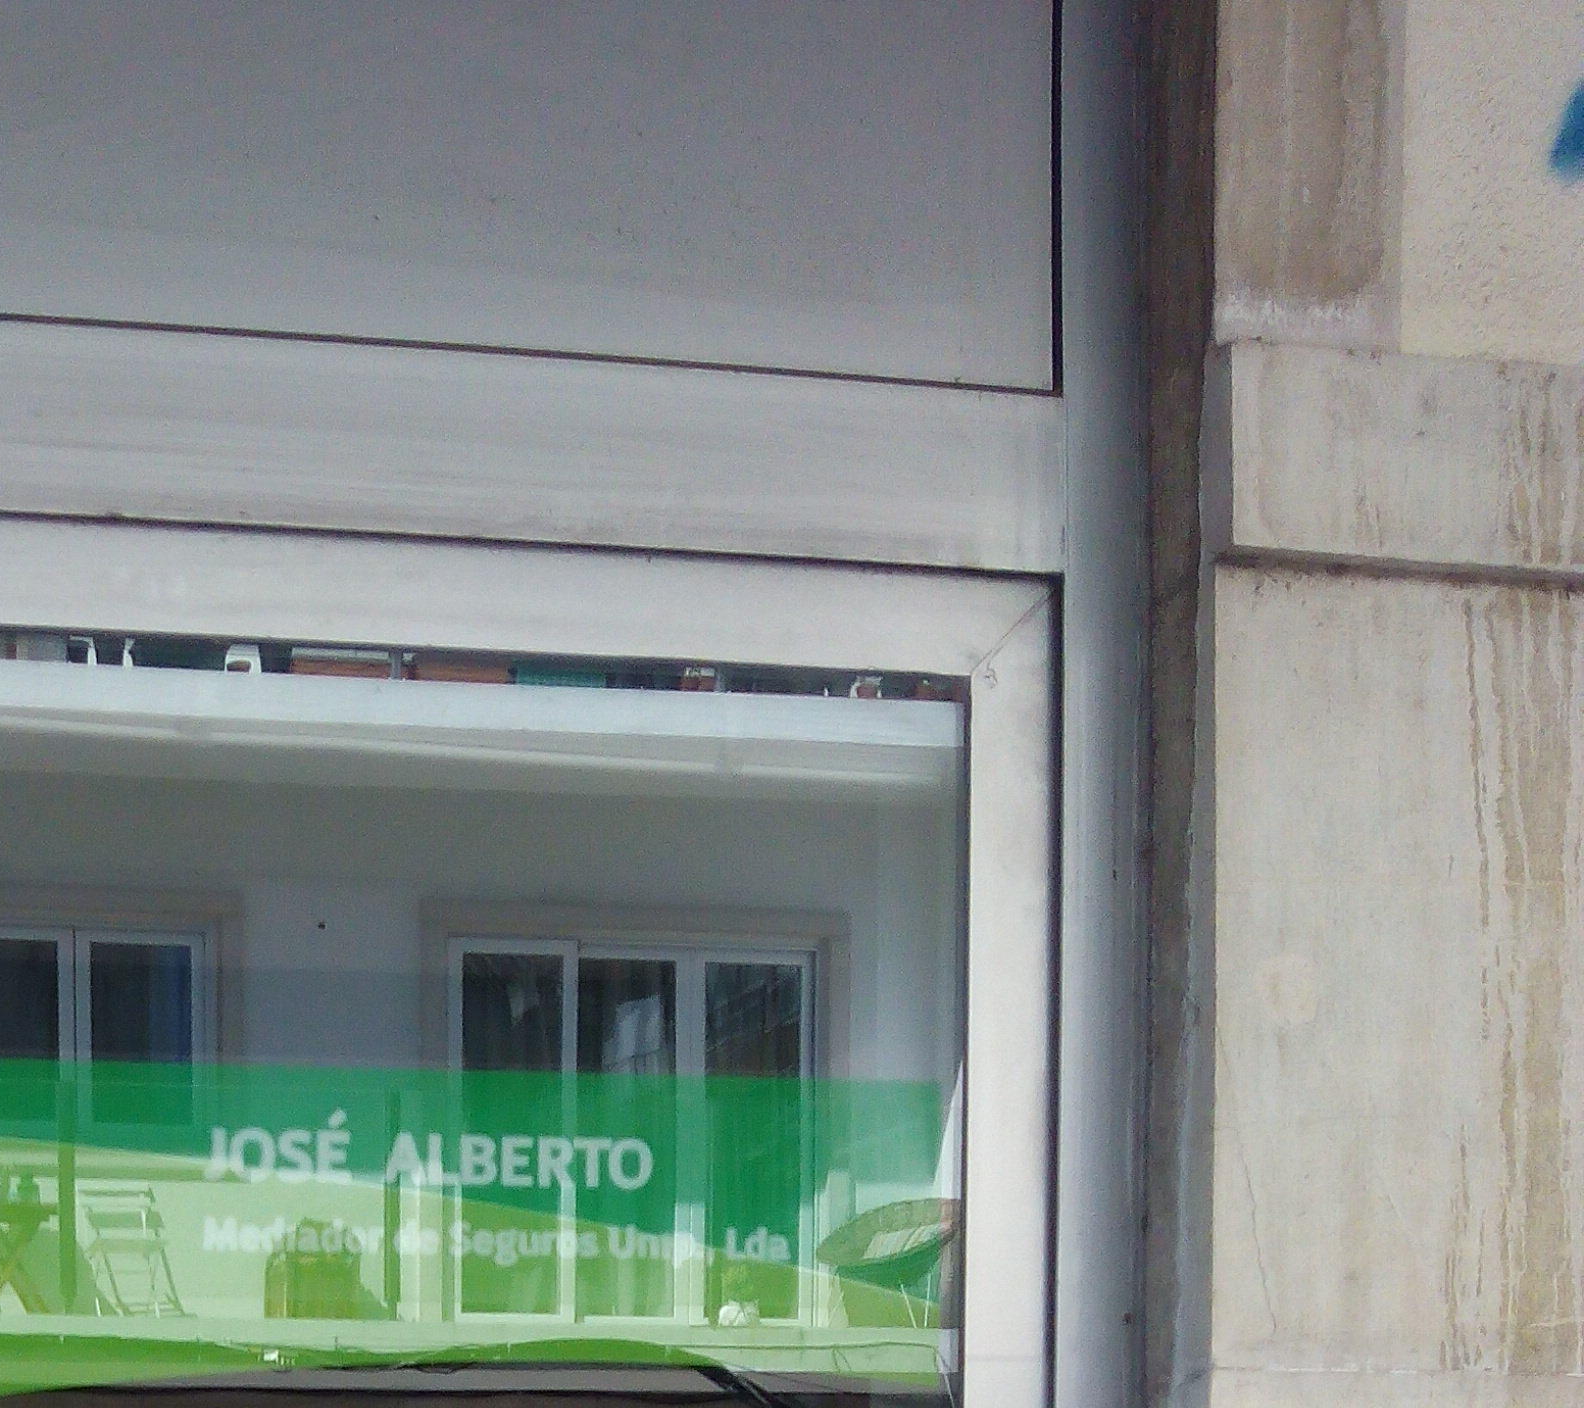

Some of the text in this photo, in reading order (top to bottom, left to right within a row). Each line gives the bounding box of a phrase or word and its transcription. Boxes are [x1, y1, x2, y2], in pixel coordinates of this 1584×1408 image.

[204, 1108, 654, 1191] JOSÉ ALBERTO
[449, 1221, 597, 1267] Seguros
